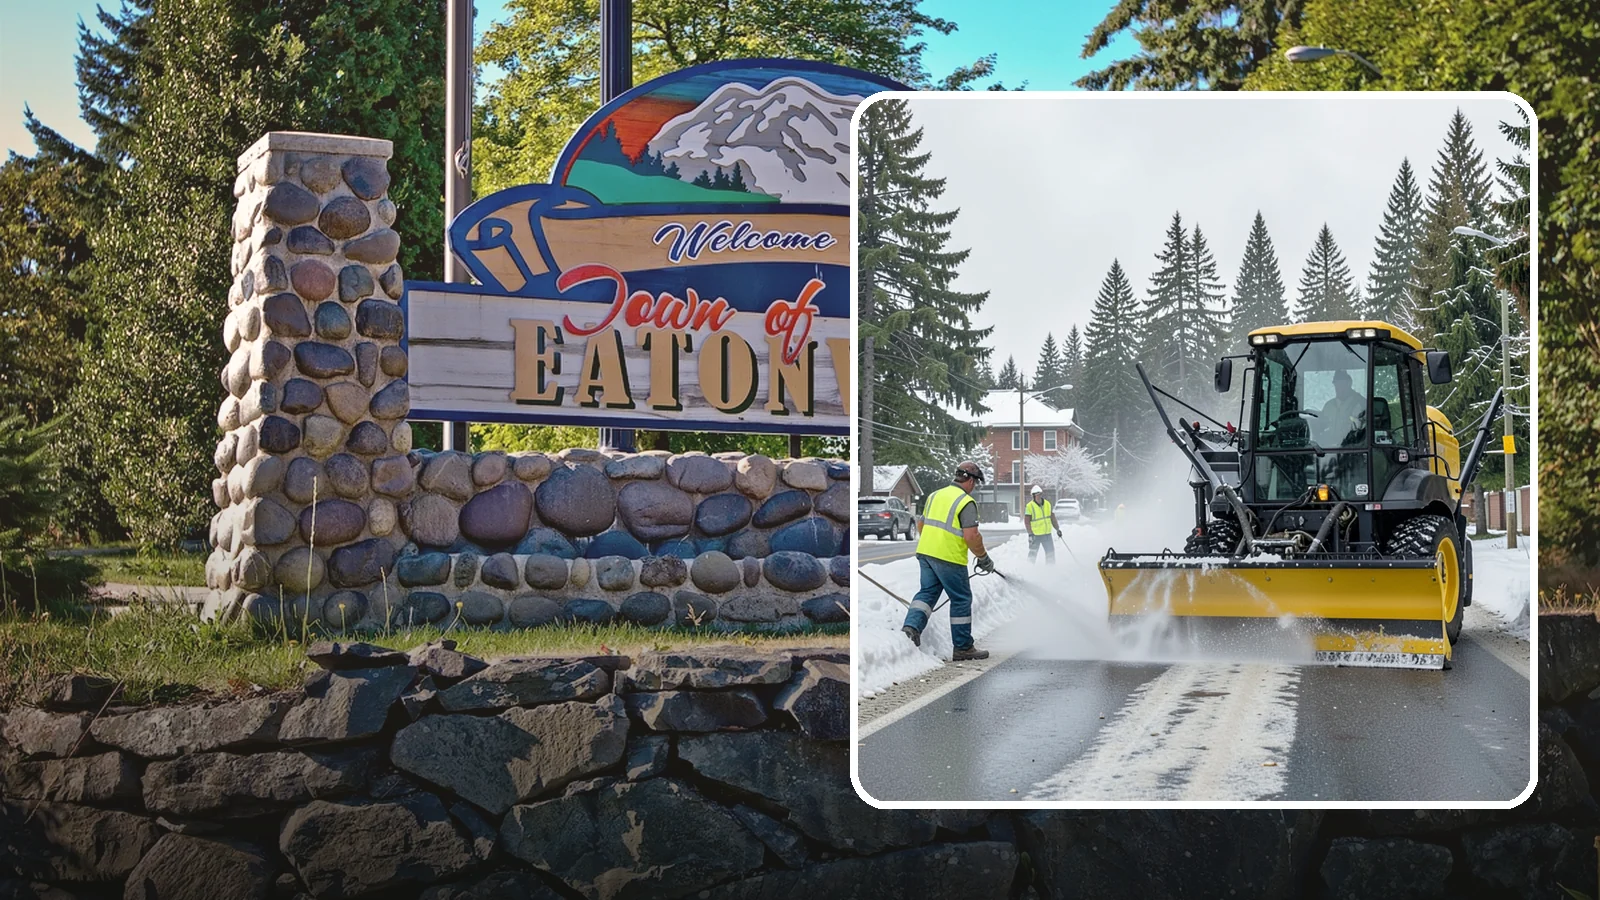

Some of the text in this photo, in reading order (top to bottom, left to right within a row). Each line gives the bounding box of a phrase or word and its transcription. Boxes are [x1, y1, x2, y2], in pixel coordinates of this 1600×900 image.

[653, 221, 837, 263] Welcome
[557, 264, 826, 366] Town of
